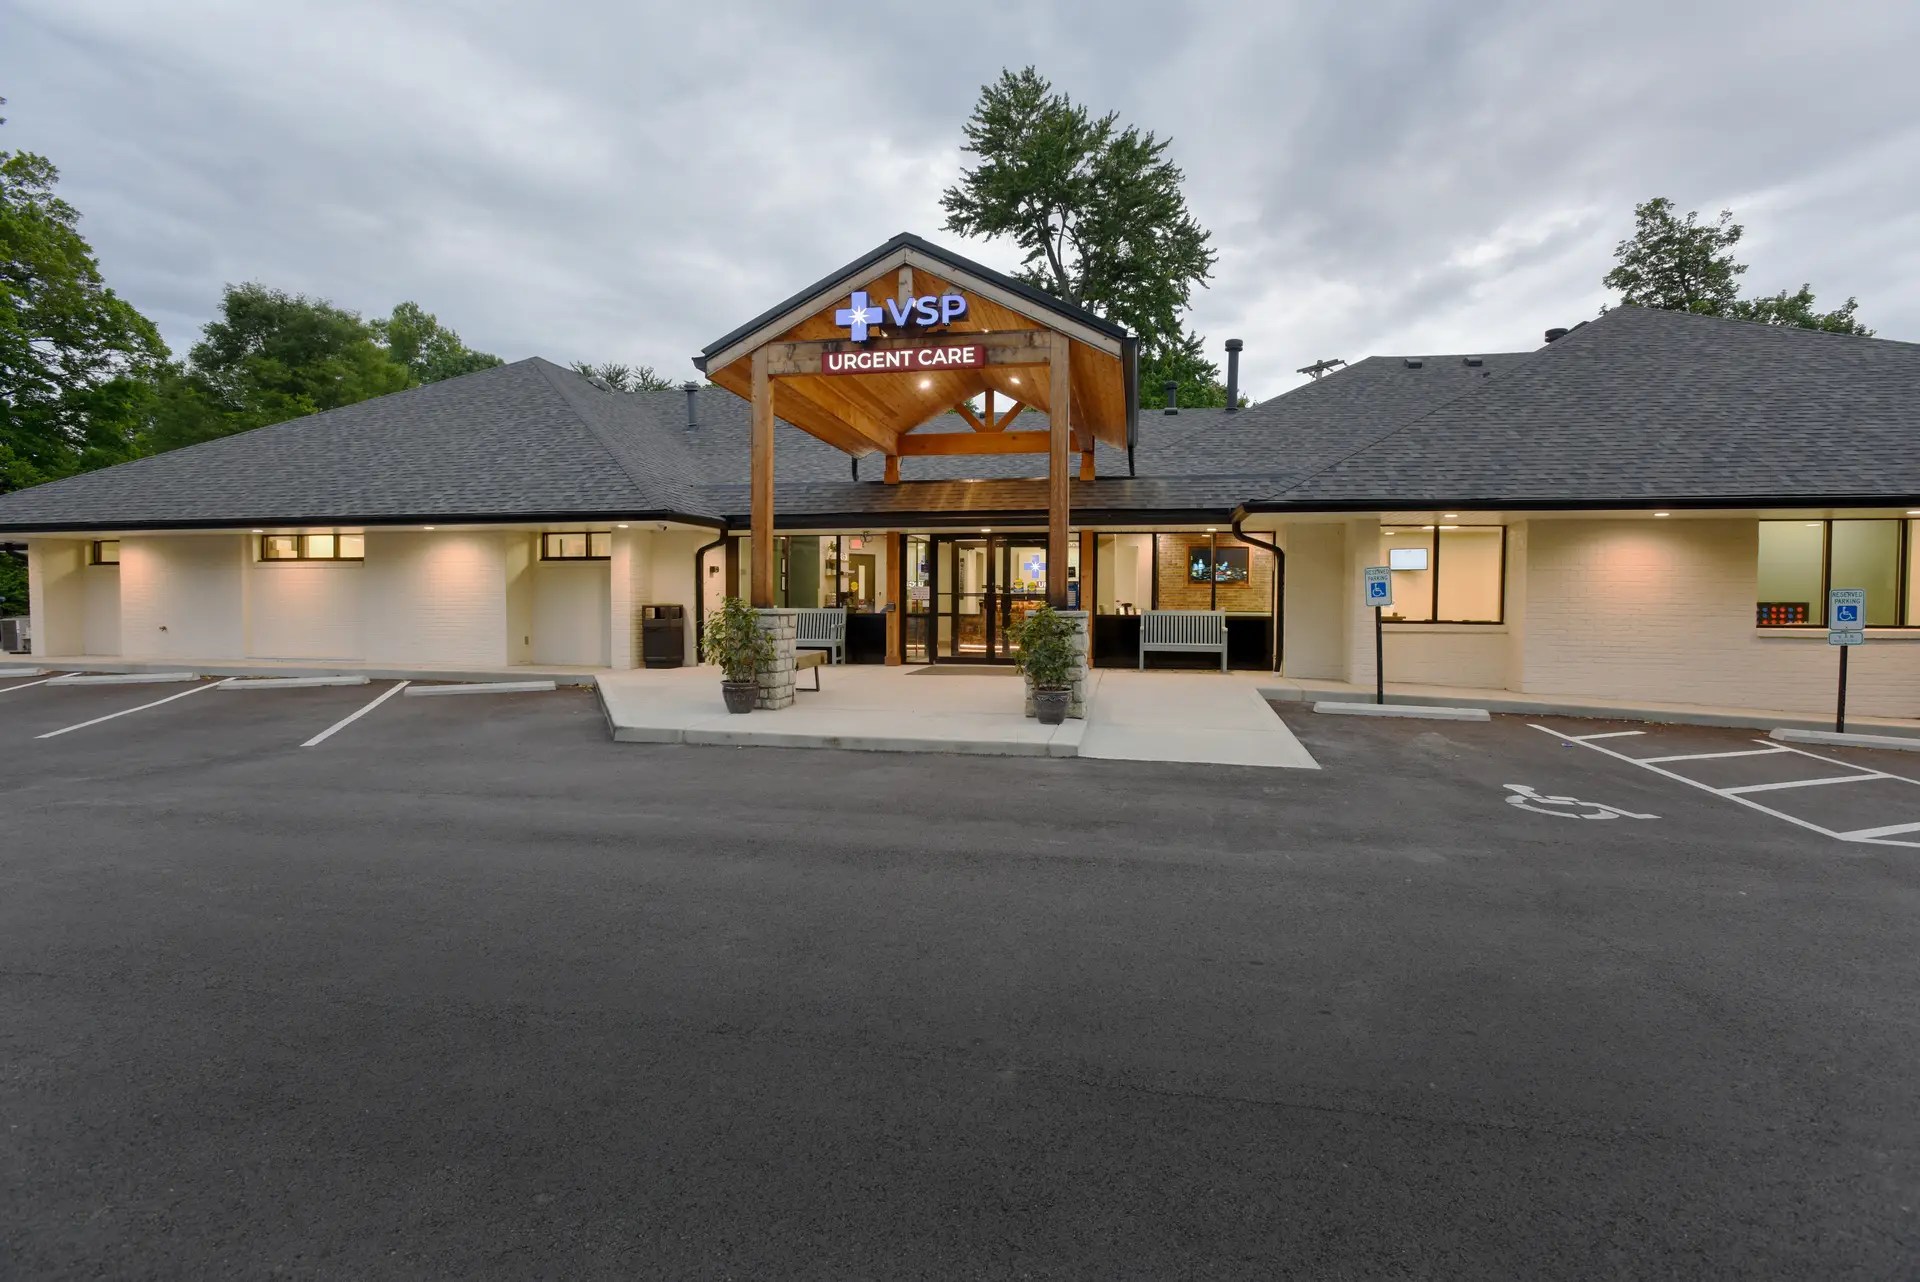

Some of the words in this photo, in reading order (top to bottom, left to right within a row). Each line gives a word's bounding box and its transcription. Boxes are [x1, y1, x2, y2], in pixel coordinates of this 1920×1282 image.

[887, 295, 967, 327] VSP
[828, 350, 913, 370] URGENT
[918, 347, 975, 366] CARE
